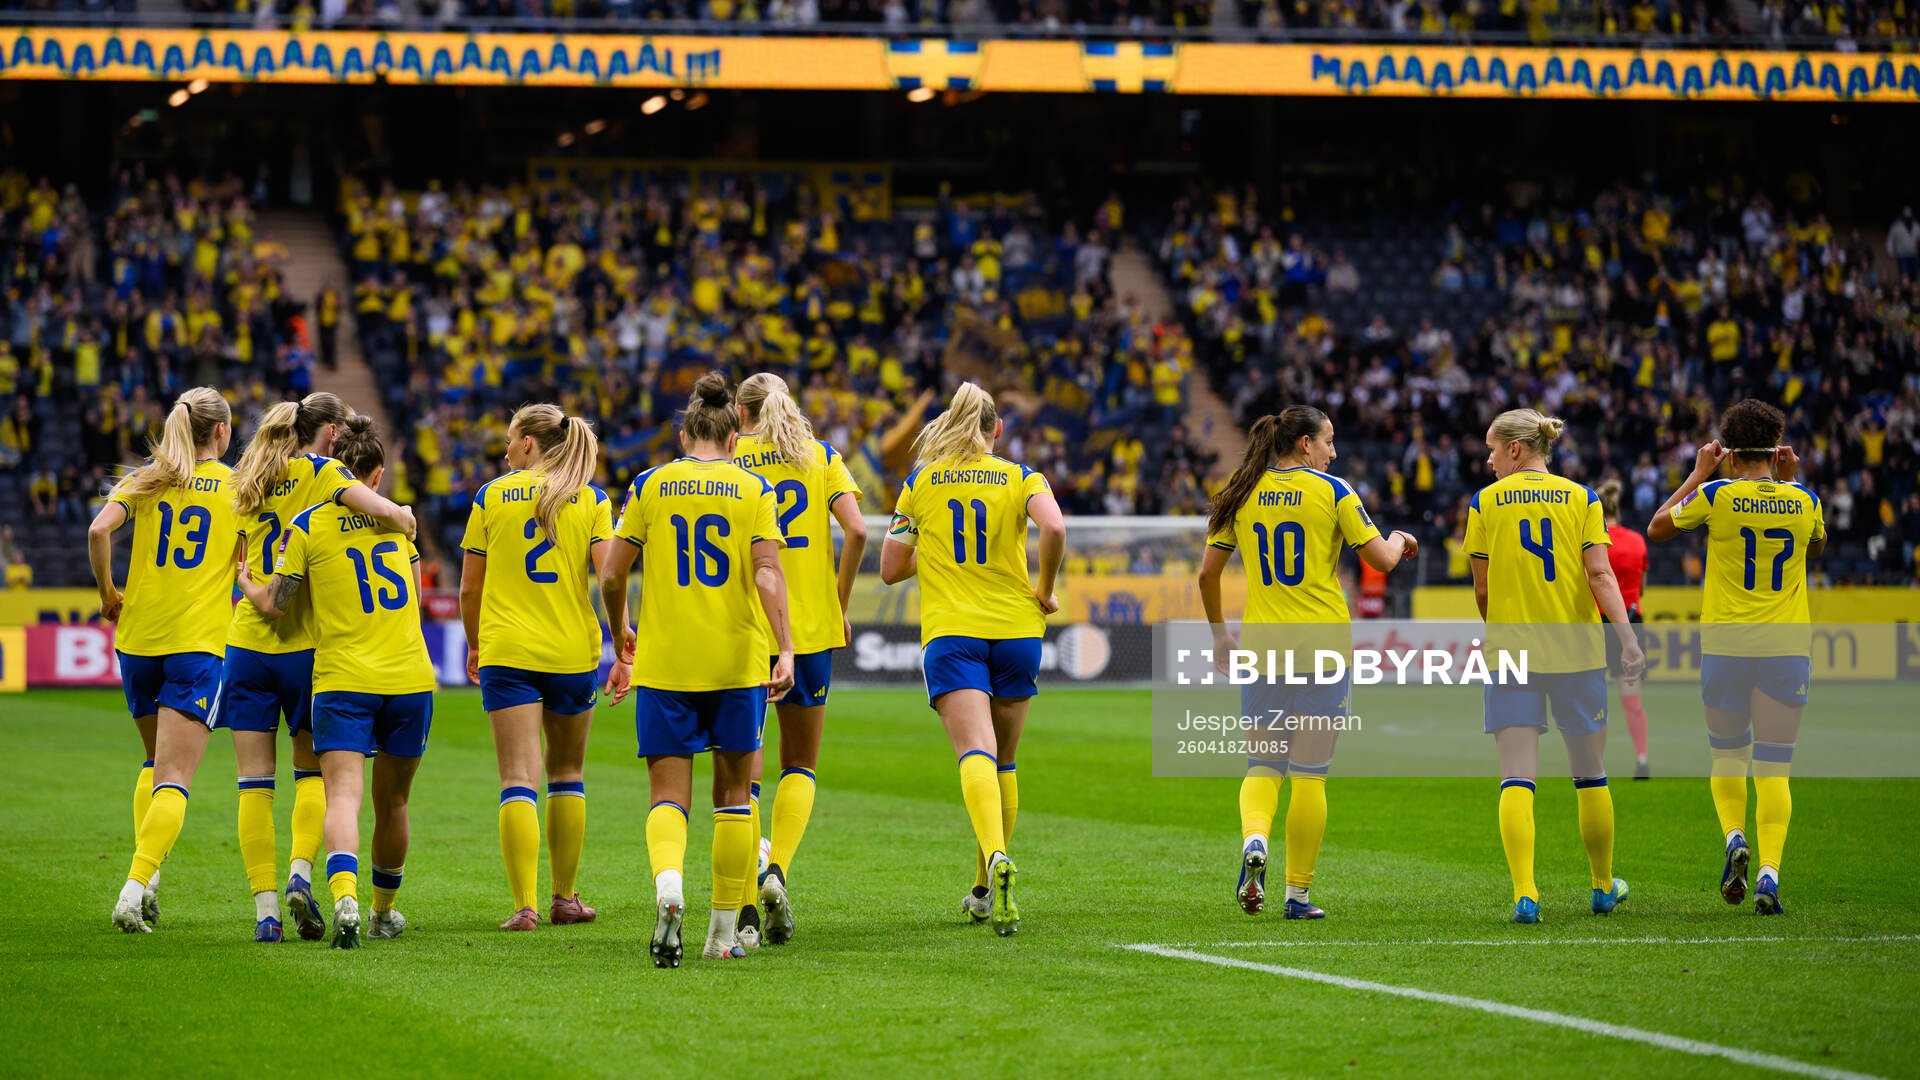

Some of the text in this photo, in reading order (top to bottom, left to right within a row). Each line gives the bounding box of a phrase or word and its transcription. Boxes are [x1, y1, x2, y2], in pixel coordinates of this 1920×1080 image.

[659, 479, 743, 500] ANGELDAHL
[931, 470, 1008, 486] BLACKSTENIUS
[1257, 491, 1303, 507] KAFAJI
[1495, 489, 1571, 507] LUNDKVIST
[1732, 496, 1803, 515] SCHRÖDER
[156, 500, 212, 569] 13
[523, 516, 559, 584] 2
[670, 513, 731, 587] 16
[947, 498, 988, 565] 11
[1252, 521, 1306, 587] 10
[1519, 517, 1556, 582] 4
[1739, 526, 1795, 592] 17
[345, 540, 409, 614] 15
